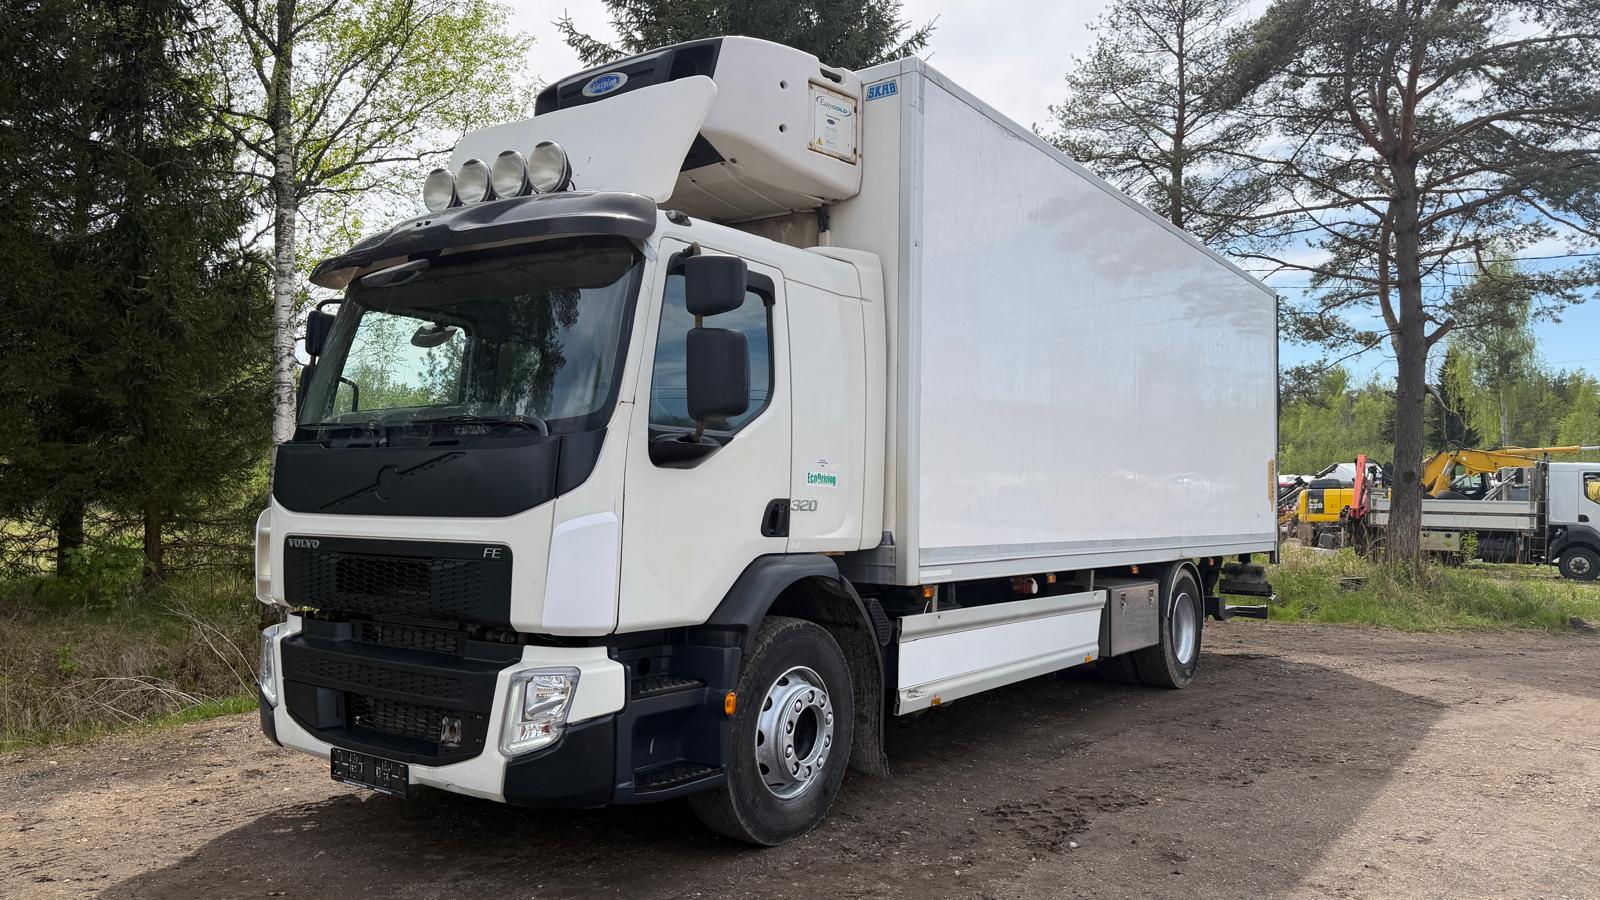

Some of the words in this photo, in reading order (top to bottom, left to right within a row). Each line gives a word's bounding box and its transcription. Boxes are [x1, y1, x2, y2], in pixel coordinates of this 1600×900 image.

[867, 81, 897, 99] SKAB
[790, 499, 818, 512] 320
[288, 538, 320, 549] VOLVO
[483, 547, 503, 559] FE
